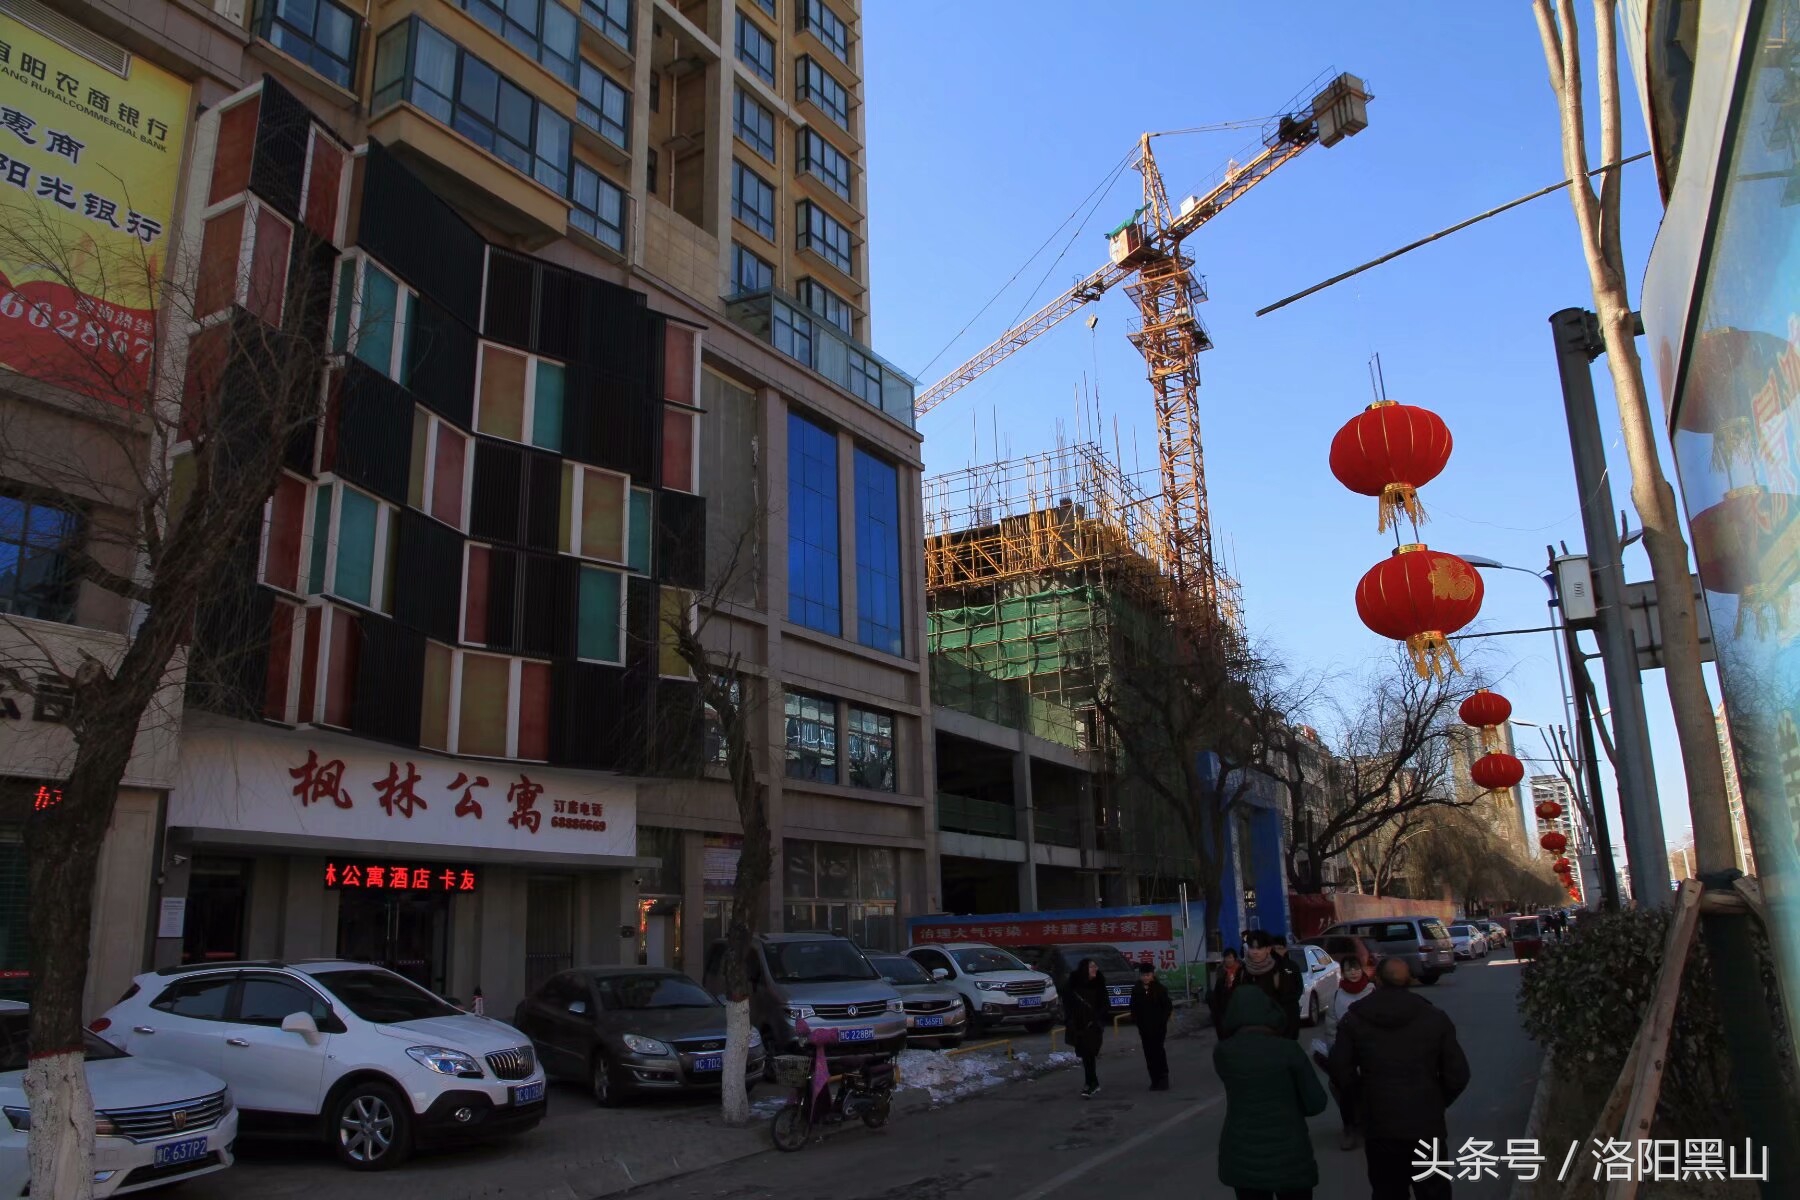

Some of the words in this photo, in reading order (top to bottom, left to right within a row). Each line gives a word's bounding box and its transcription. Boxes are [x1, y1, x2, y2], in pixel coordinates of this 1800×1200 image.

[0, 64, 28, 84] ANG
[140, 136, 168, 153] BANK
[289, 749, 545, 834] 枫林公寓
[438, 868, 476, 891] 卡友
